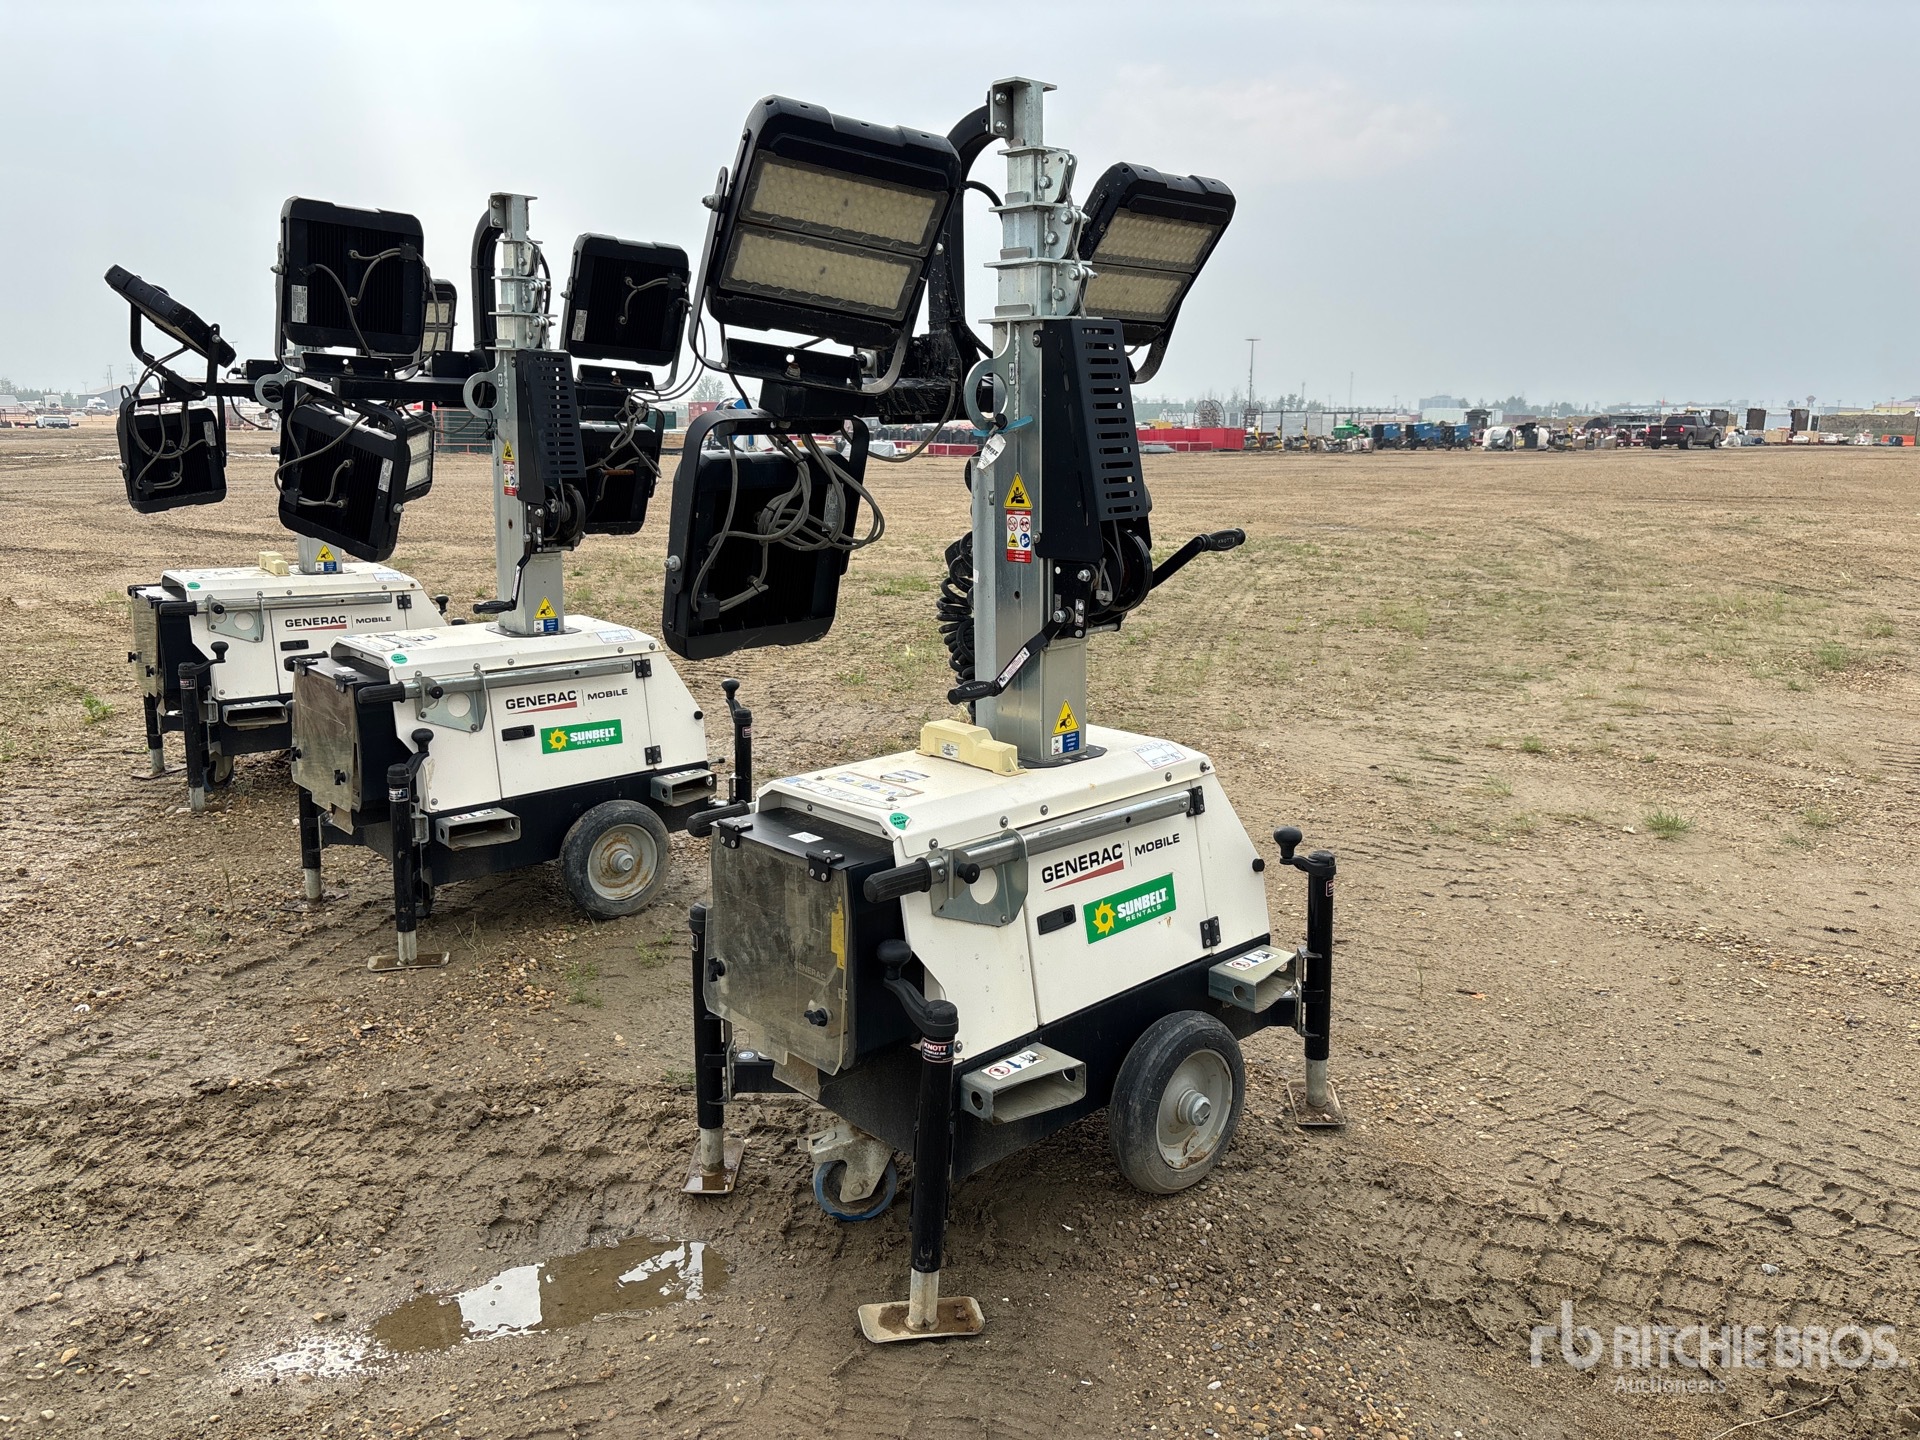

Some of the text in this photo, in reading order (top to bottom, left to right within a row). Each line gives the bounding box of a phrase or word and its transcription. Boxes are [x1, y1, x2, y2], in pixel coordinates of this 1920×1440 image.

[285, 615, 392, 628] GENERAC MOBILE
[505, 688, 628, 710] GENERAC MOBILE
[569, 727, 616, 742] SUNBELT
[577, 738, 610, 746] RENTALS
[1041, 833, 1180, 883] GENERAC MOBILE
[1116, 887, 1168, 919] SUNBELT
[1125, 904, 1162, 923] RENTALS
[924, 1042, 947, 1052] KNOTT
